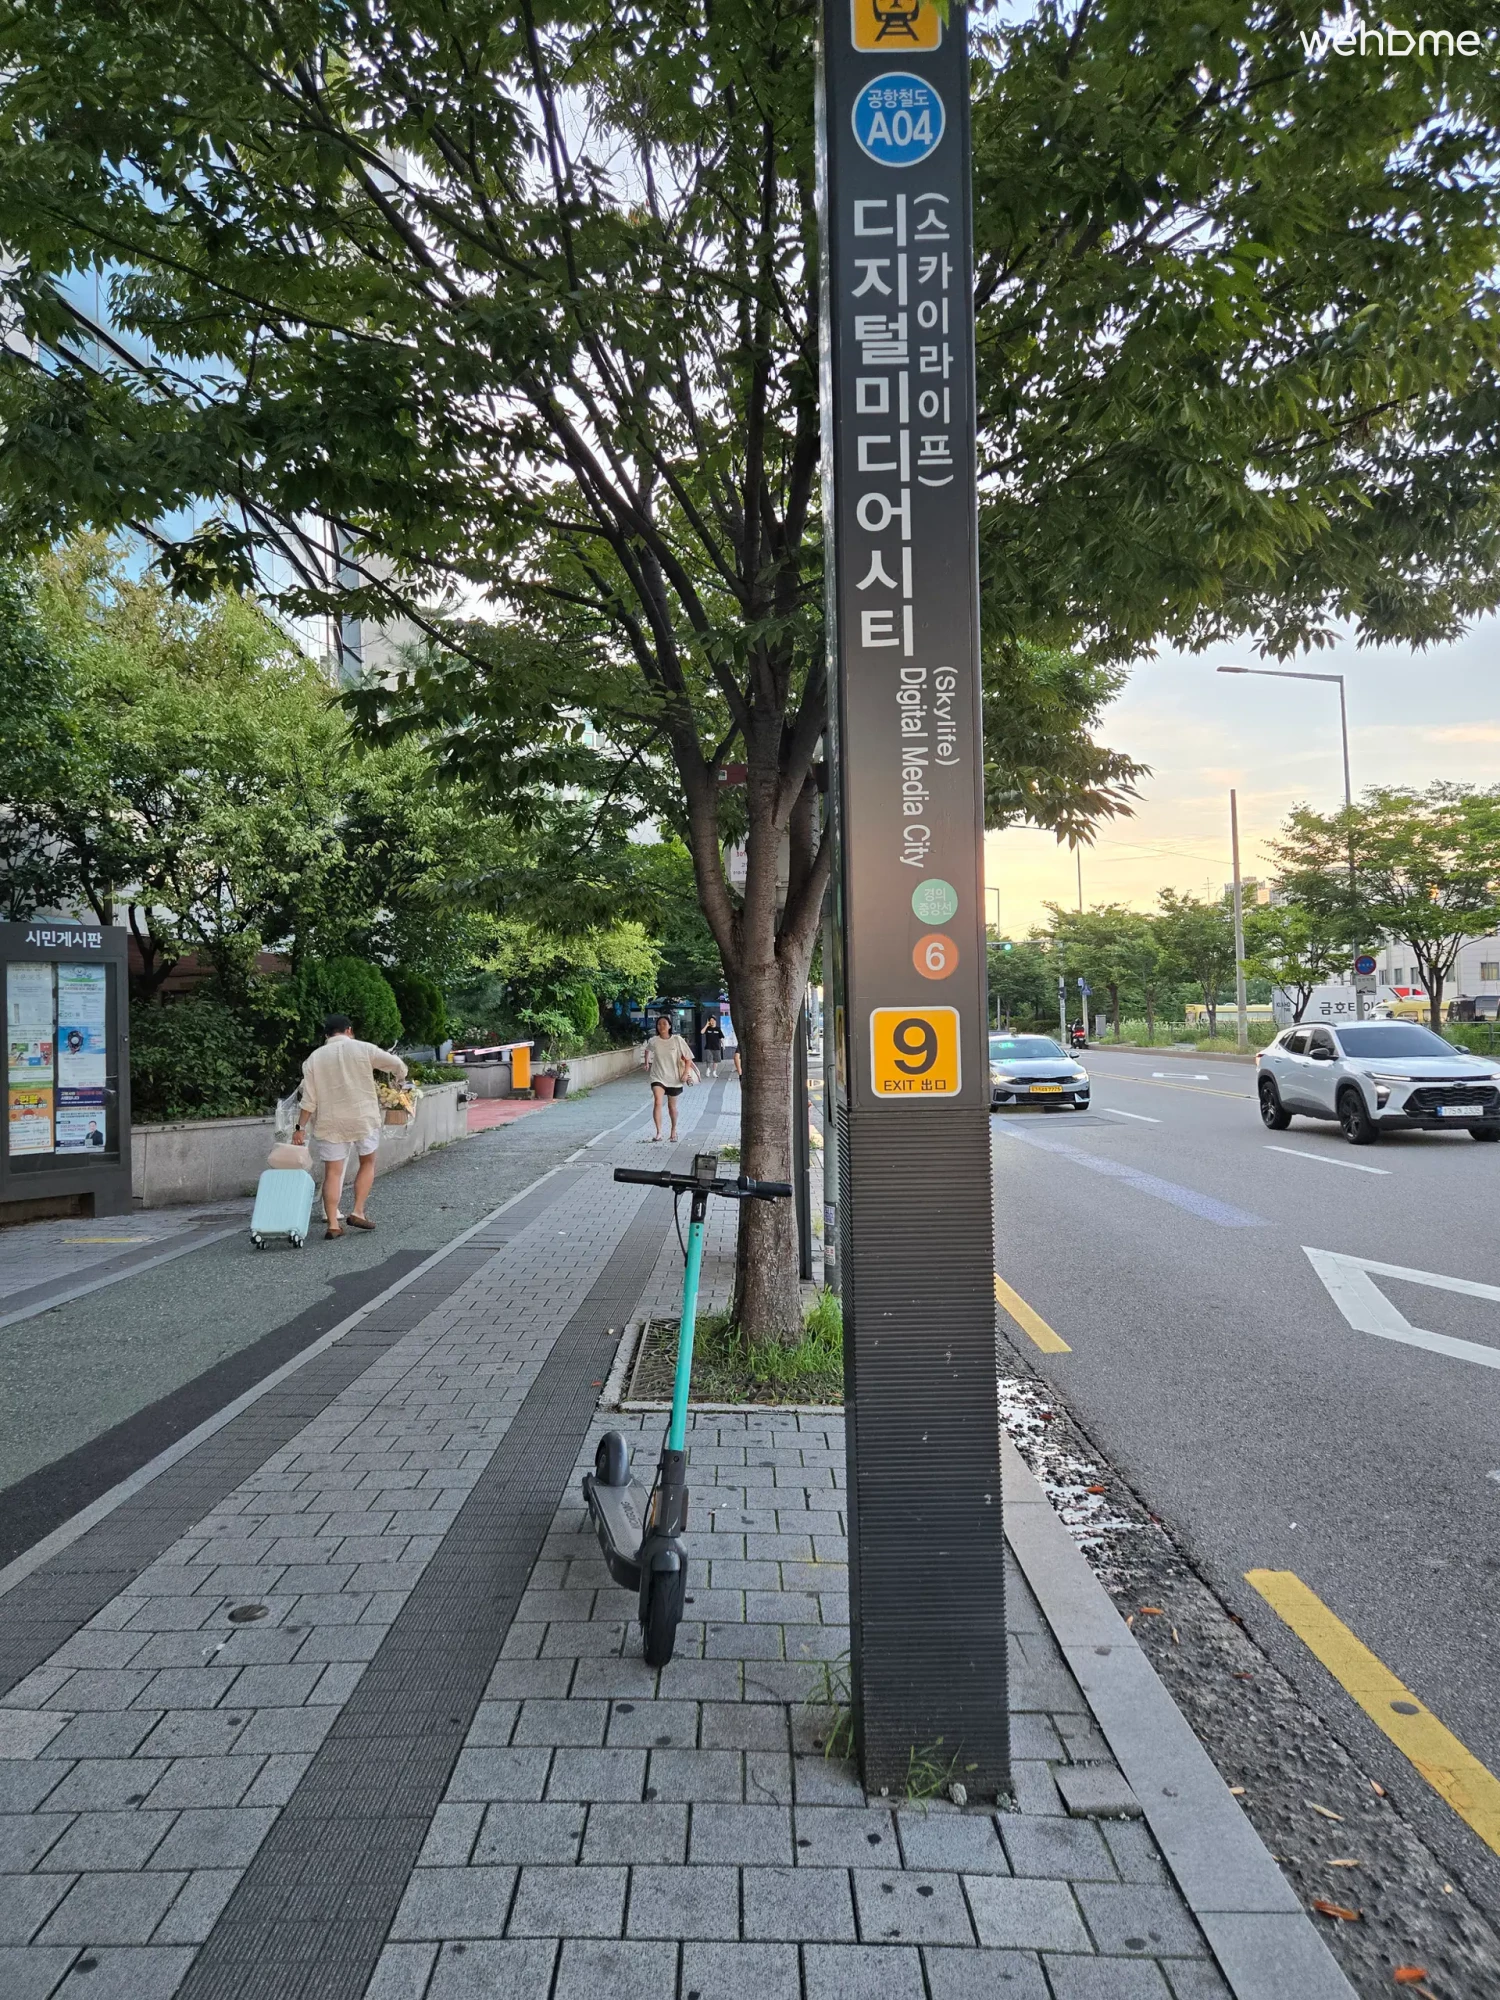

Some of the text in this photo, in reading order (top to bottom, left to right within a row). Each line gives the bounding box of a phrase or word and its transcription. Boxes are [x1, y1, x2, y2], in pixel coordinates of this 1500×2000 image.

[867, 88, 930, 109] 공항철도
[866, 110, 934, 147] A04
[913, 192, 955, 487] (스카이라이프)
[851, 193, 914, 657] 디지털미디어시티
[932, 665, 961, 766] (Skylife)
[895, 667, 931, 868] Digital Media City
[918, 902, 953, 916] 중앙선
[924, 887, 947, 902] 경의
[25, 930, 103, 948] 시민게시판
[925, 942, 946, 971] 6
[892, 1017, 939, 1076] 9
[884, 1078, 947, 1091] EXIT 出口
